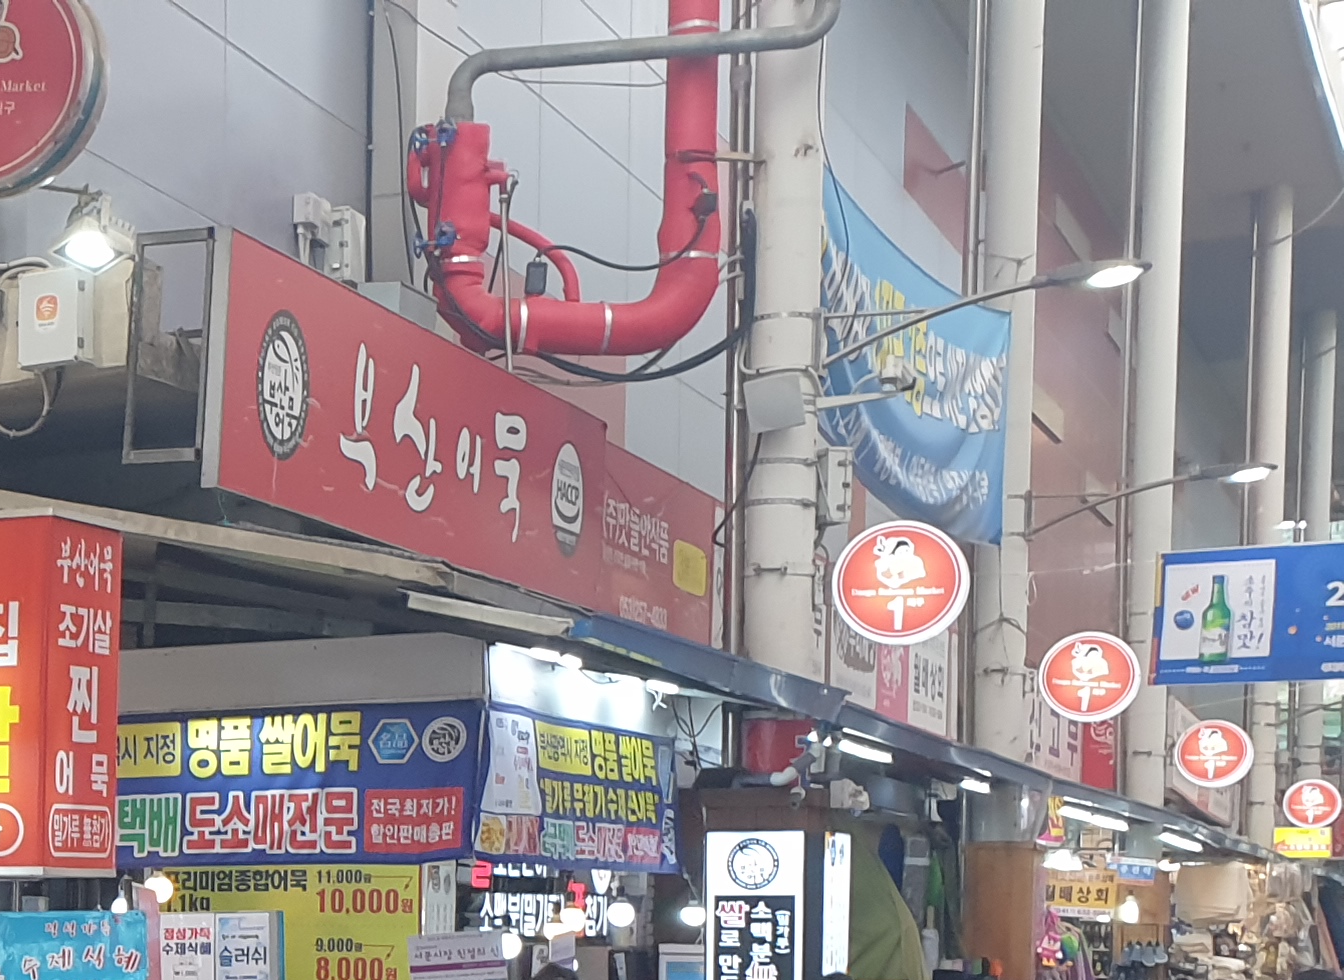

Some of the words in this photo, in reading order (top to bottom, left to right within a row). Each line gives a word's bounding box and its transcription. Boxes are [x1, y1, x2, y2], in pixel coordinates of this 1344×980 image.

[0, 80, 47, 93] Market
[339, 341, 527, 543] 부산어묵
[56, 536, 113, 593] 부산어묵
[57, 603, 113, 656] 조기살
[887, 595, 904, 631] 1
[66, 665, 100, 744] 찐
[143, 733, 177, 764] 지정
[187, 715, 252, 778] 명품
[258, 711, 362, 775] 쌀어묵
[591, 729, 620, 781] 명품
[53, 813, 80, 848] 밀가루
[116, 794, 181, 857] 택배
[183, 788, 359, 854] 도소매전문
[218, 947, 268, 967] 슬러쉬
